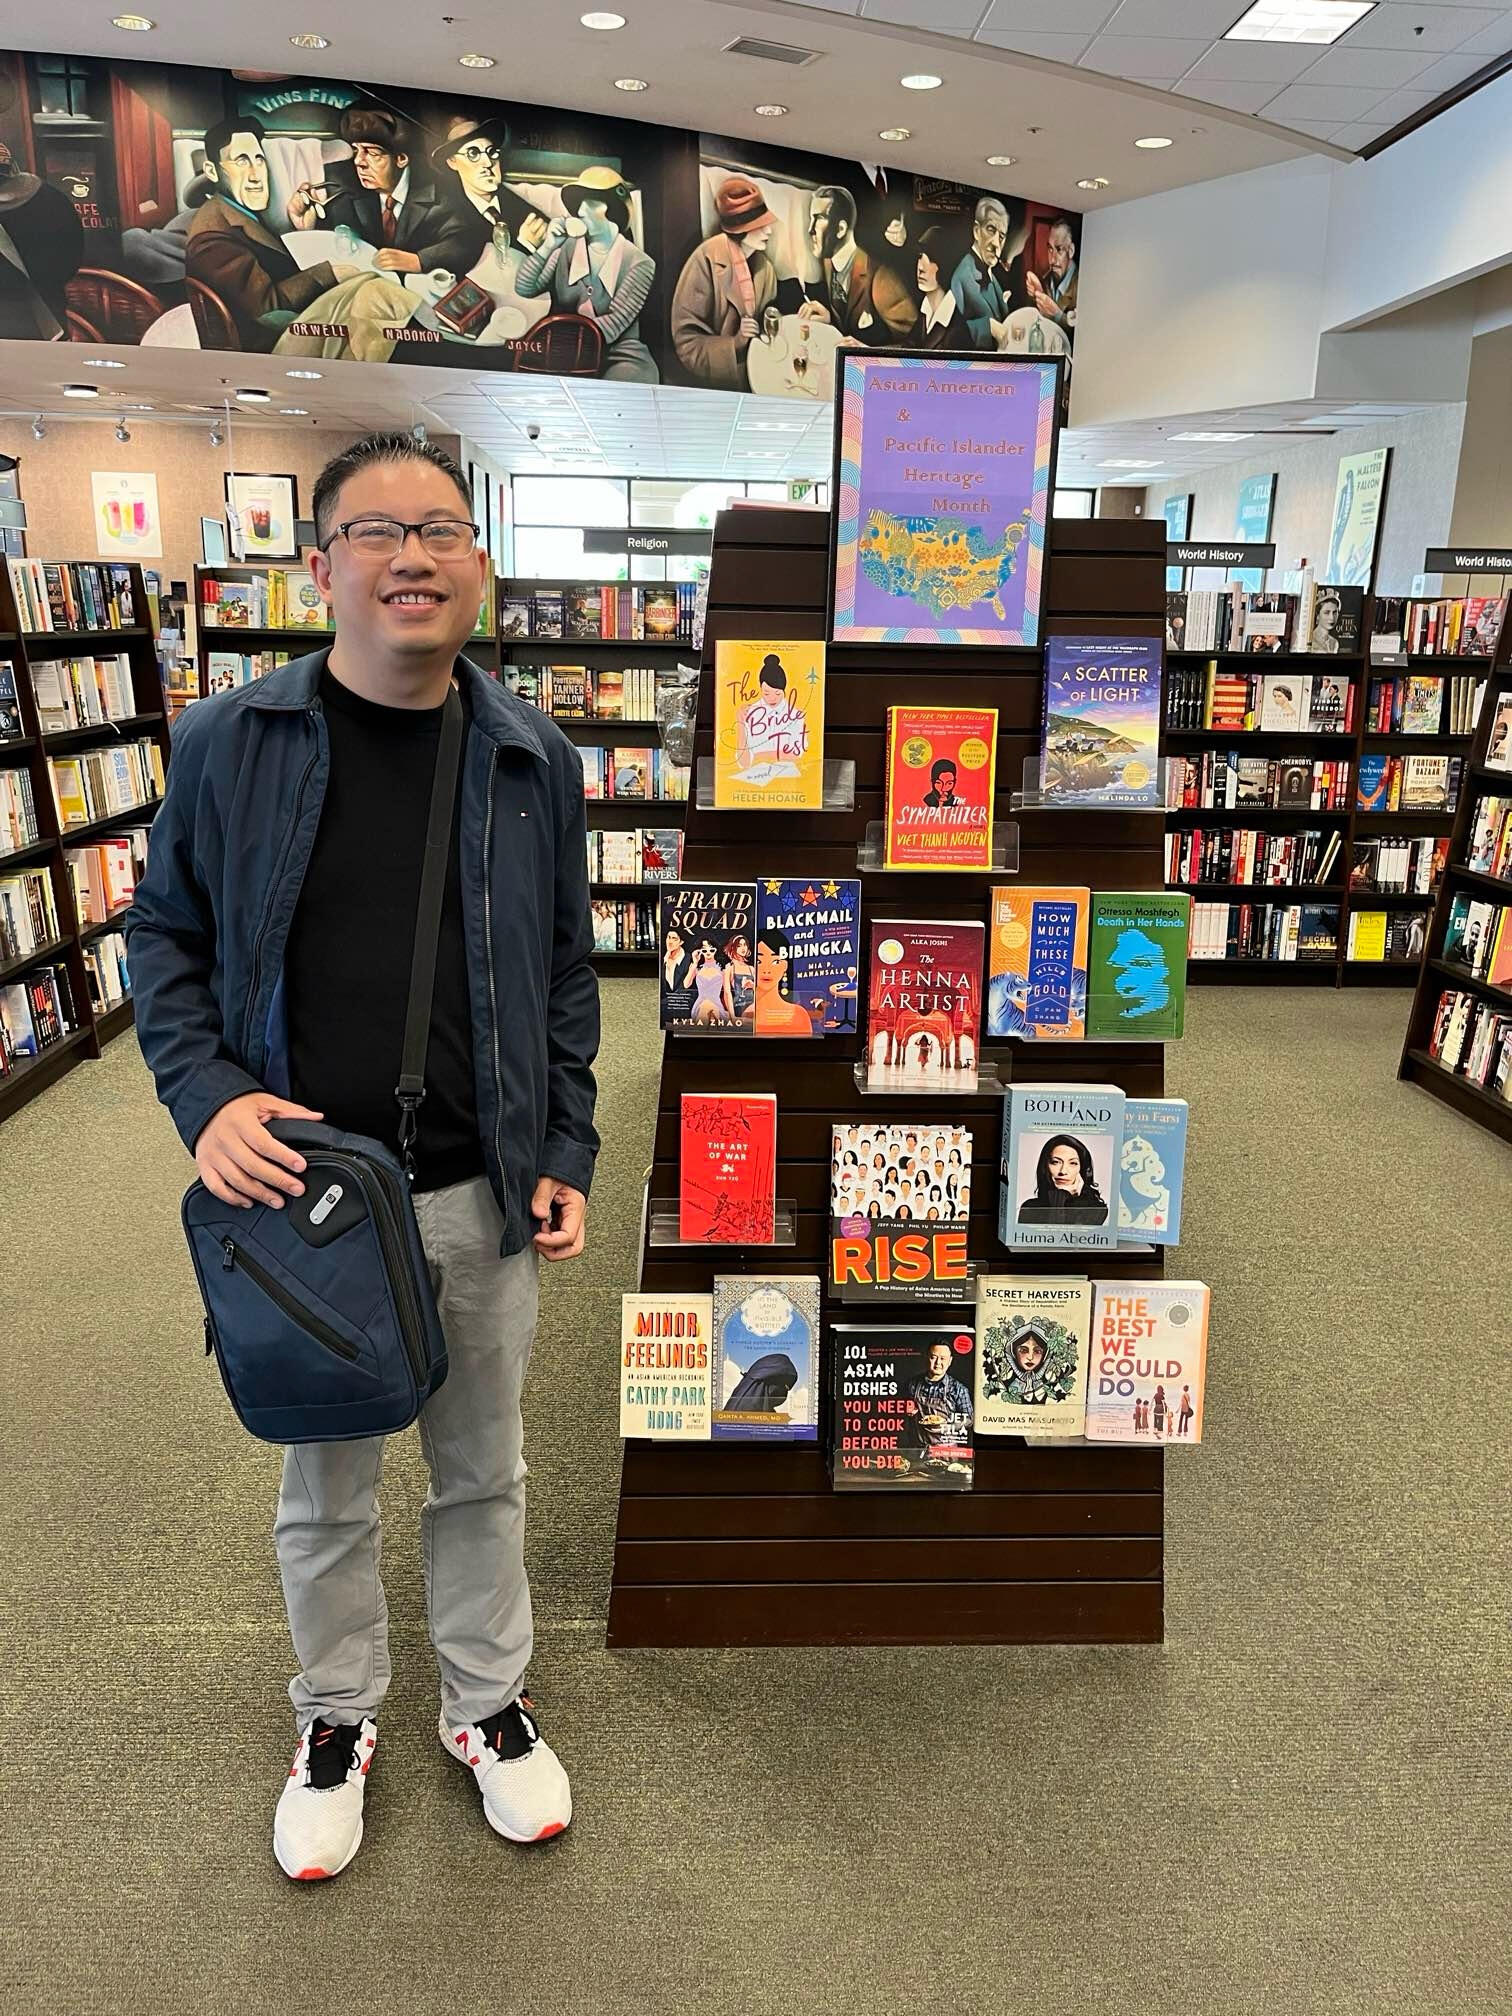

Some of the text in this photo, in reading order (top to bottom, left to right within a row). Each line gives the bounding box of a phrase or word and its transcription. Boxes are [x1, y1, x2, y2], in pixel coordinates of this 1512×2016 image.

[255, 90, 302, 113] VINS
[293, 324, 345, 337] ORWELL
[386, 328, 441, 343] NABOKOV
[508, 340, 543, 353] JOYCE
[868, 376, 1015, 395] Asian American
[896, 408, 911, 422] &
[884, 437, 1025, 455] Pacific Islander
[904, 468, 985, 490] Heritage
[932, 498, 991, 513] Month
[627, 537, 668, 550] Religion
[1177, 549, 1244, 563] World History
[1454, 556, 1512, 568] World Histo
[1062, 667, 1149, 684] A SCATTER
[553, 685, 585, 695] TANNER
[726, 670, 759, 706] The
[1070, 687, 1140, 702] OF LIGHT
[553, 694, 584, 705] HOLLOW
[745, 687, 807, 736] Bride
[768, 723, 811, 762] Test
[1280, 758, 1313, 766] CHERNOBYL
[1416, 767, 1440, 776] BAZAAR
[732, 792, 807, 804] HELEN HOANG
[897, 805, 988, 825] SYMPATHIZER
[897, 831, 988, 848] VIET THANH NGUYEN
[644, 870, 678, 880] RIVERS
[674, 891, 753, 912] FRAUD
[766, 908, 853, 930] BLACKMAIL
[1038, 913, 1071, 922] HOW
[1098, 907, 1180, 918] Ottessa Moshfegh
[669, 910, 748, 936] SQUAD
[1097, 917, 1185, 928] Death in Her Hands
[793, 929, 814, 940] and
[1037, 926, 1070, 937] MUCH
[778, 939, 853, 960] BIBINGKA
[1035, 949, 1069, 960] THESE
[808, 962, 823, 970] MIA
[919, 954, 935, 964] The
[1035, 966, 1066, 976] HILLS
[880, 969, 971, 989] HENNA
[1034, 984, 1066, 998] GOLD
[880, 993, 970, 1013] ARTIST
[673, 1018, 743, 1028] KYLA ZHAO
[1024, 1100, 1073, 1113] BOTH
[1071, 1109, 1112, 1122] AND
[1138, 1111, 1149, 1121] in
[1152, 1111, 1180, 1123] Farsi
[707, 1142, 749, 1151] THE ART
[708, 1151, 747, 1161] OF WAR
[1014, 1232, 1055, 1244] Huma
[1059, 1232, 1109, 1245] Abedin
[833, 1233, 968, 1284] RISE
[986, 1288, 1081, 1299] SECRET HARVESTS
[1103, 1296, 1149, 1317] THE
[636, 1311, 698, 1338] MINOR
[1102, 1318, 1157, 1338] BEST
[843, 1345, 868, 1360] 101
[1100, 1338, 1136, 1357] WE
[624, 1343, 708, 1369] FEELINGS
[843, 1363, 895, 1378] ASIAN
[1098, 1358, 1183, 1379] COULD
[843, 1381, 898, 1396] DISHES
[1098, 1378, 1135, 1397] DO
[626, 1385, 706, 1406] CATHY PARK
[843, 1400, 917, 1414] YOU NEED
[647, 1410, 683, 1430] HONG
[843, 1418, 905, 1431] TO COOK
[947, 1412, 969, 1424] JET
[982, 1415, 1005, 1423] DAVID
[1008, 1416, 1026, 1424] MAS
[940, 1423, 968, 1436] TILA
[842, 1436, 899, 1450] BEFORE
[842, 1455, 904, 1470] YOU DIE
